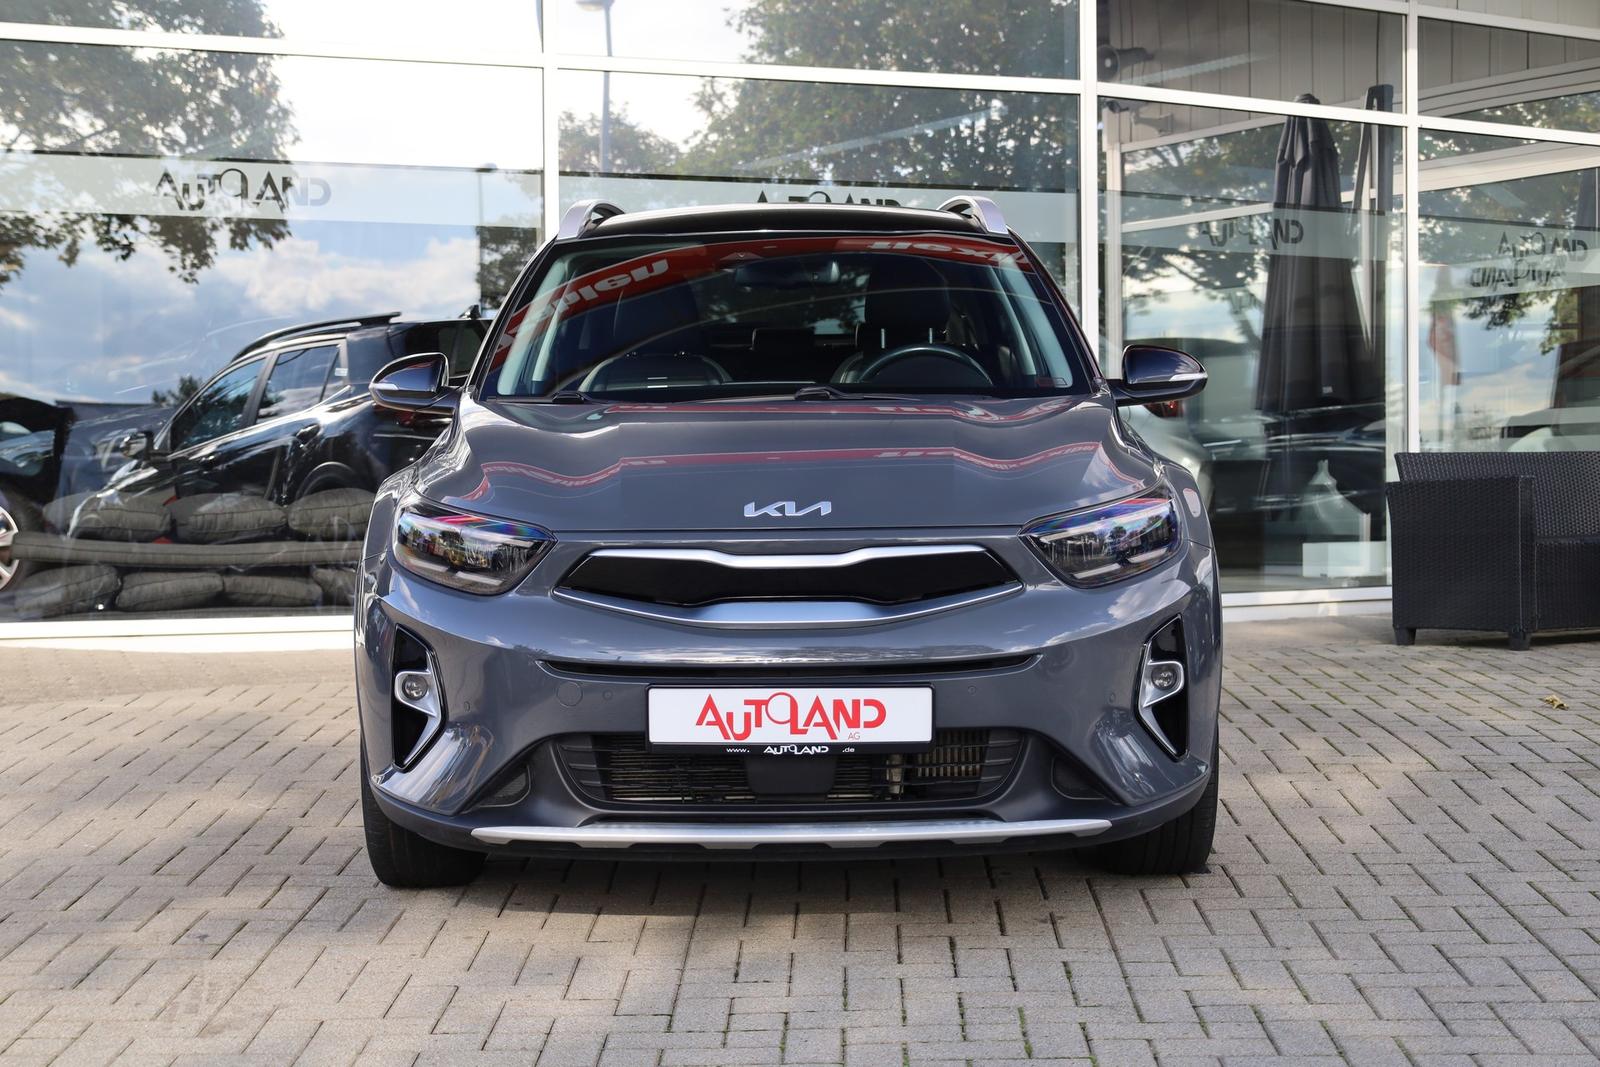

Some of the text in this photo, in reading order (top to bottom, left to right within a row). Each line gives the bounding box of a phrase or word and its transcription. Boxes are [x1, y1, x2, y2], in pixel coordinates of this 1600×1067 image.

[155, 168, 331, 214] AUTOLAND
[744, 501, 832, 517] KIA
[695, 692, 887, 740] AUTOLAND
[848, 732, 861, 740] AG
[763, 744, 829, 755] AUTOLAND
